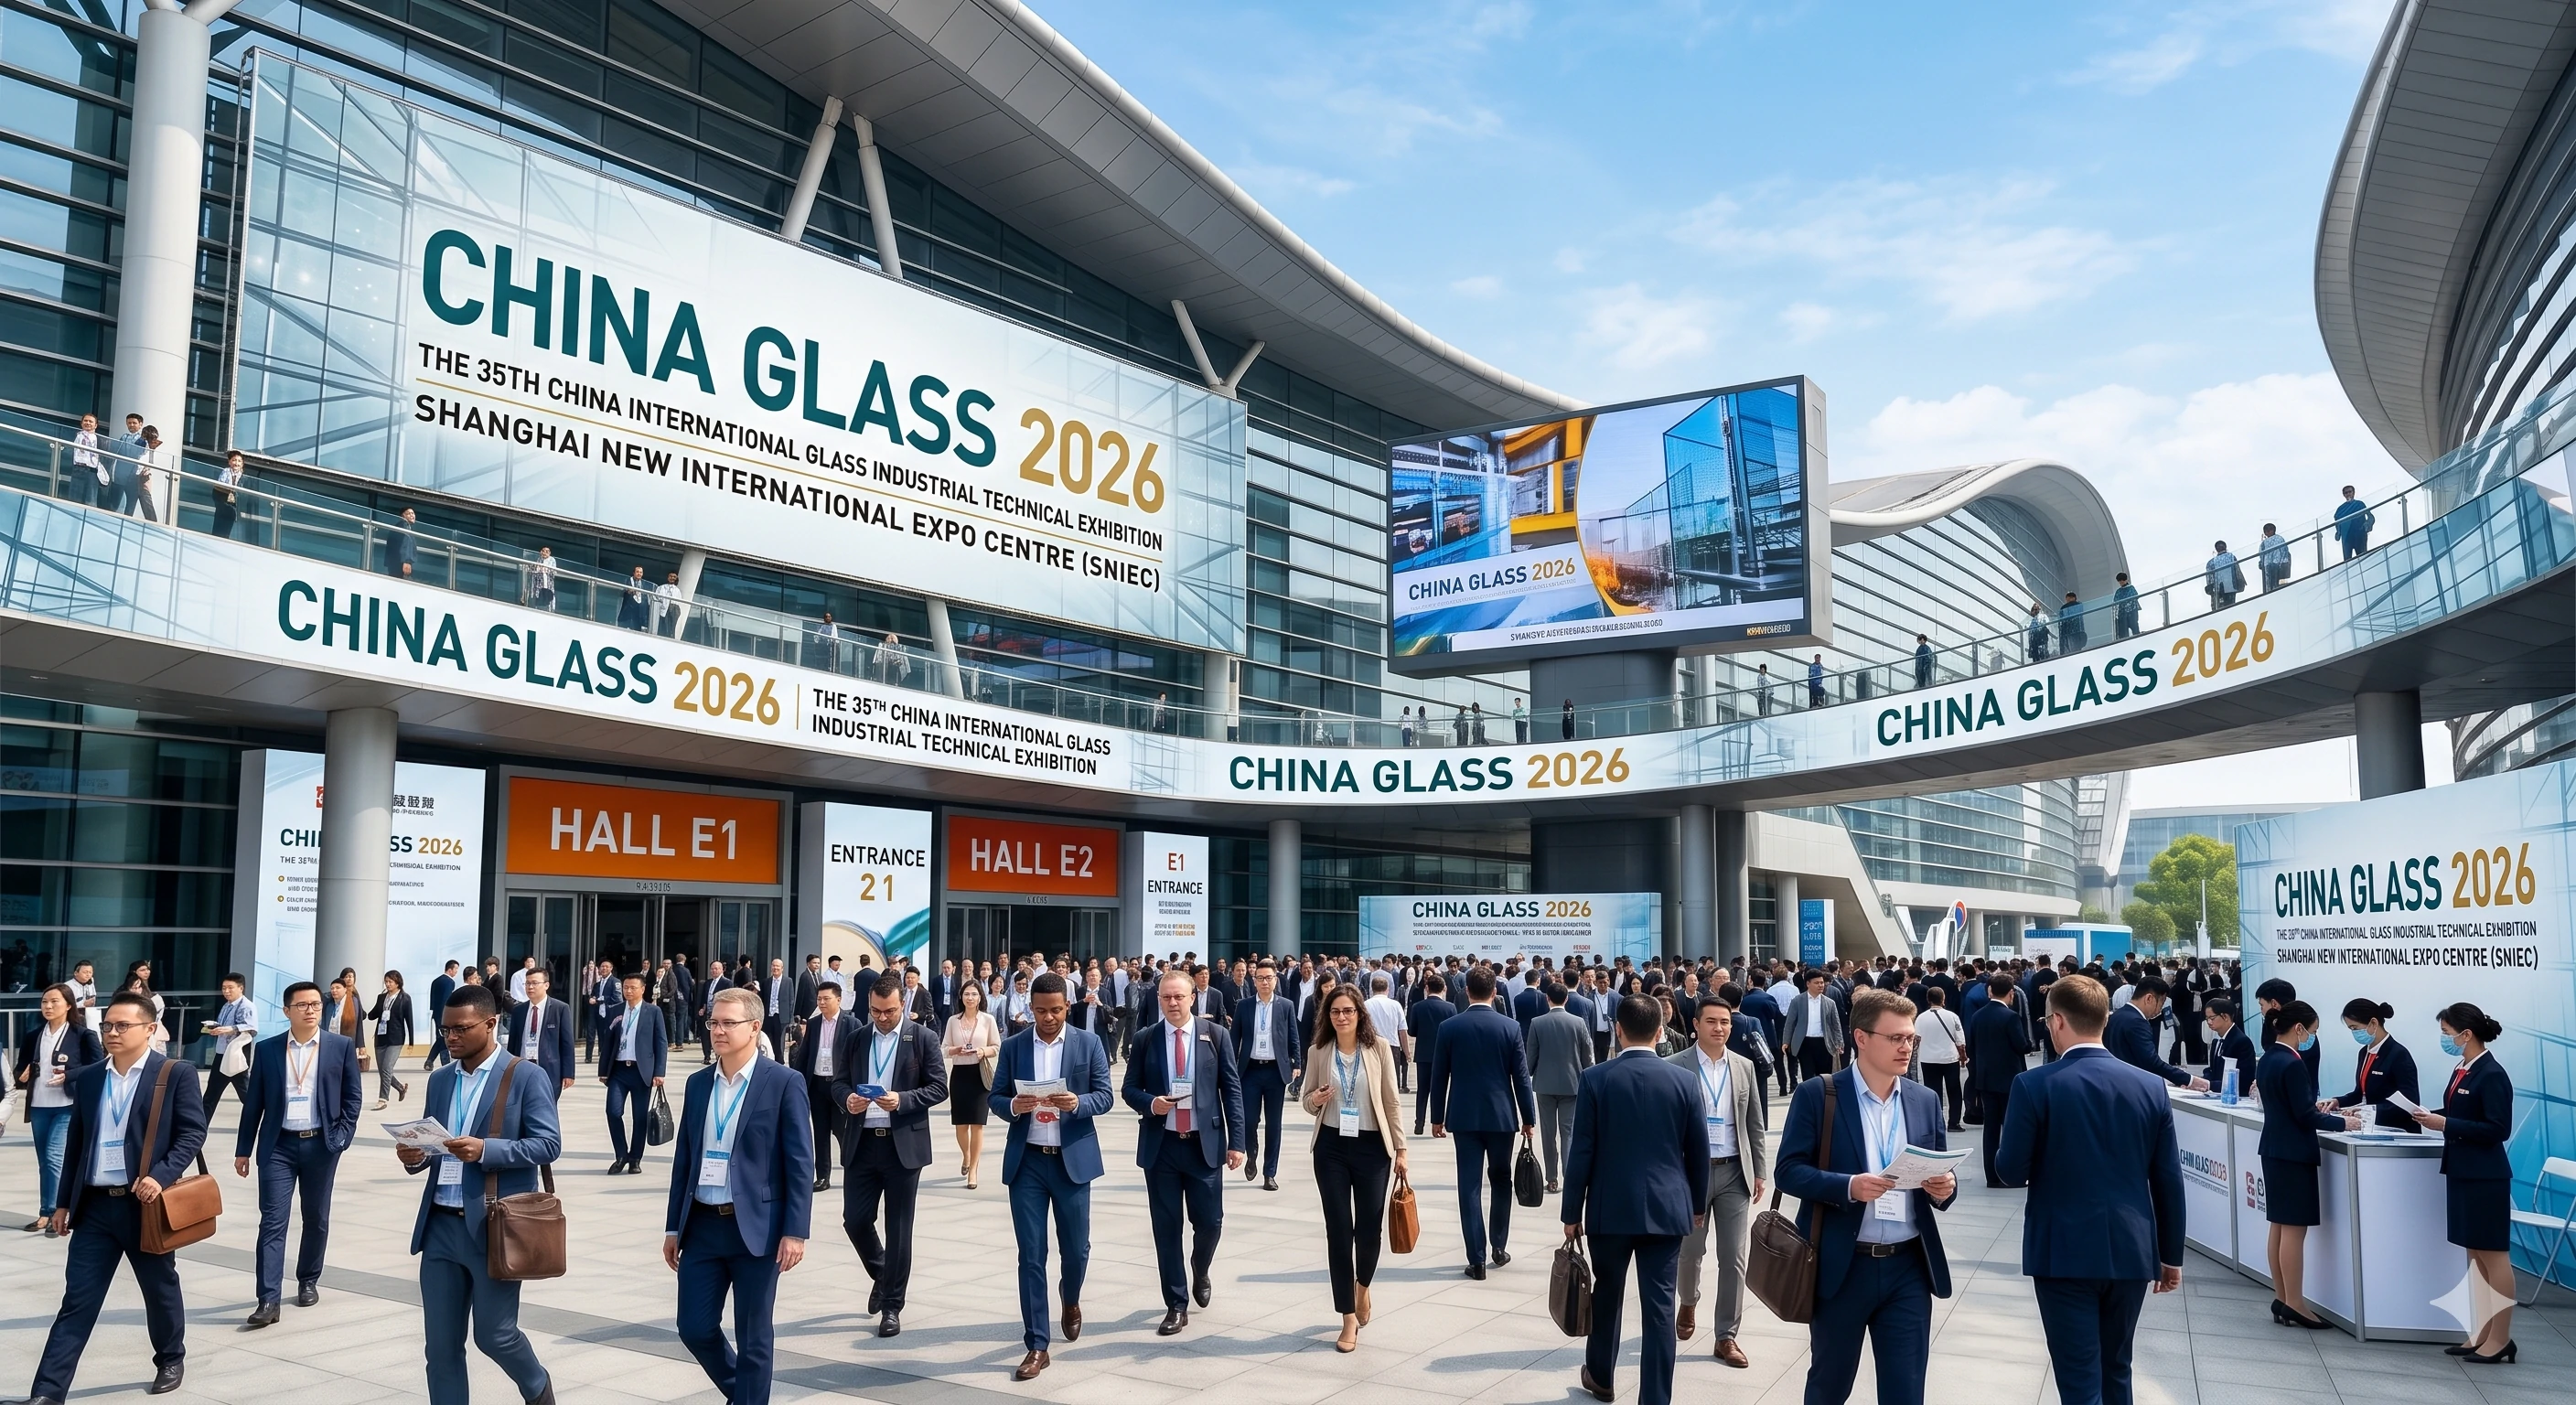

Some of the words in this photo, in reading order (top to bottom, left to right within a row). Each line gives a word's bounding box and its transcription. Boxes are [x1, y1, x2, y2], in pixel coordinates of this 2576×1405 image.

[424, 230, 715, 395] CHINA
[744, 327, 996, 467] GLASS
[1020, 408, 1165, 513] 2026
[419, 342, 469, 378] THE
[478, 359, 539, 395] 35TH
[549, 378, 621, 416] CHINA
[629, 398, 800, 460] INTERNATIONAL
[806, 445, 866, 477] GLASS
[874, 461, 978, 505] INDUSTRIAL
[983, 489, 1073, 529] TECHNICAL
[1079, 514, 1162, 551] EXHIBITION
[414, 395, 589, 458] SHANGHAI
[602, 438, 671, 477] NEW
[682, 457, 904, 531] INTERNATIONAL
[913, 512, 975, 546] EXPO
[985, 531, 1074, 571] CENTRE
[1083, 552, 1162, 593] (SNIEC)
[1410, 577, 1464, 600] CHINA
[1469, 566, 1527, 590] GLASS
[1532, 558, 1575, 581] 2026
[279, 580, 467, 671] CHINA
[487, 624, 657, 703] GLASS
[674, 661, 779, 725] 2026
[1878, 689, 2005, 745] CHINA
[2018, 649, 2157, 721] GLASS
[2172, 611, 2274, 687] 2026
[813, 689, 847, 712] THE
[853, 696, 886, 715] 35TH
[891, 704, 940, 728] CHINA
[946, 713, 1063, 748] INTERNATIONAL
[1068, 735, 1111, 755] GLASS
[813, 714, 916, 748] INDUSTRIAL
[922, 733, 1010, 763] TECHNICAL
[1015, 748, 1096, 775] EXHIBITION
[1230, 756, 1359, 792] CHINA
[1373, 757, 1513, 792] GLASS
[1528, 748, 1629, 788] 2026
[418, 837, 463, 856] 2026
[551, 807, 675, 856] HALL
[692, 817, 736, 860] E1
[831, 844, 926, 867] ENTRANCE
[971, 838, 1050, 875] HALL
[1060, 844, 1094, 877] E2
[1168, 853, 1184, 871] E1
[2275, 868, 2345, 917] CHINA
[2351, 856, 2442, 914] GLASS
[2452, 842, 2535, 908] 2026
[1148, 880, 1203, 895] ENTRANCE
[1413, 902, 1471, 917] CHINA
[1477, 902, 1539, 917] GLASS
[1546, 901, 1591, 917] 2026
[2277, 928, 2288, 940] THE
[2301, 928, 2319, 940] CHINA
[2319, 927, 2368, 940] INTERNATIONAL
[2370, 926, 2392, 938] GLASS
[2438, 922, 2485, 938] TECHNICAL
[2486, 920, 2537, 938] EXHIBITION
[2277, 949, 2316, 963] SHANGHAI
[2317, 949, 2336, 964] NEW
[2337, 949, 2410, 965] INTERNATIONAL
[2412, 948, 2441, 966] EXPO
[2442, 948, 2488, 967] CENTRE
[2491, 945, 2538, 971] (SNIEC)
